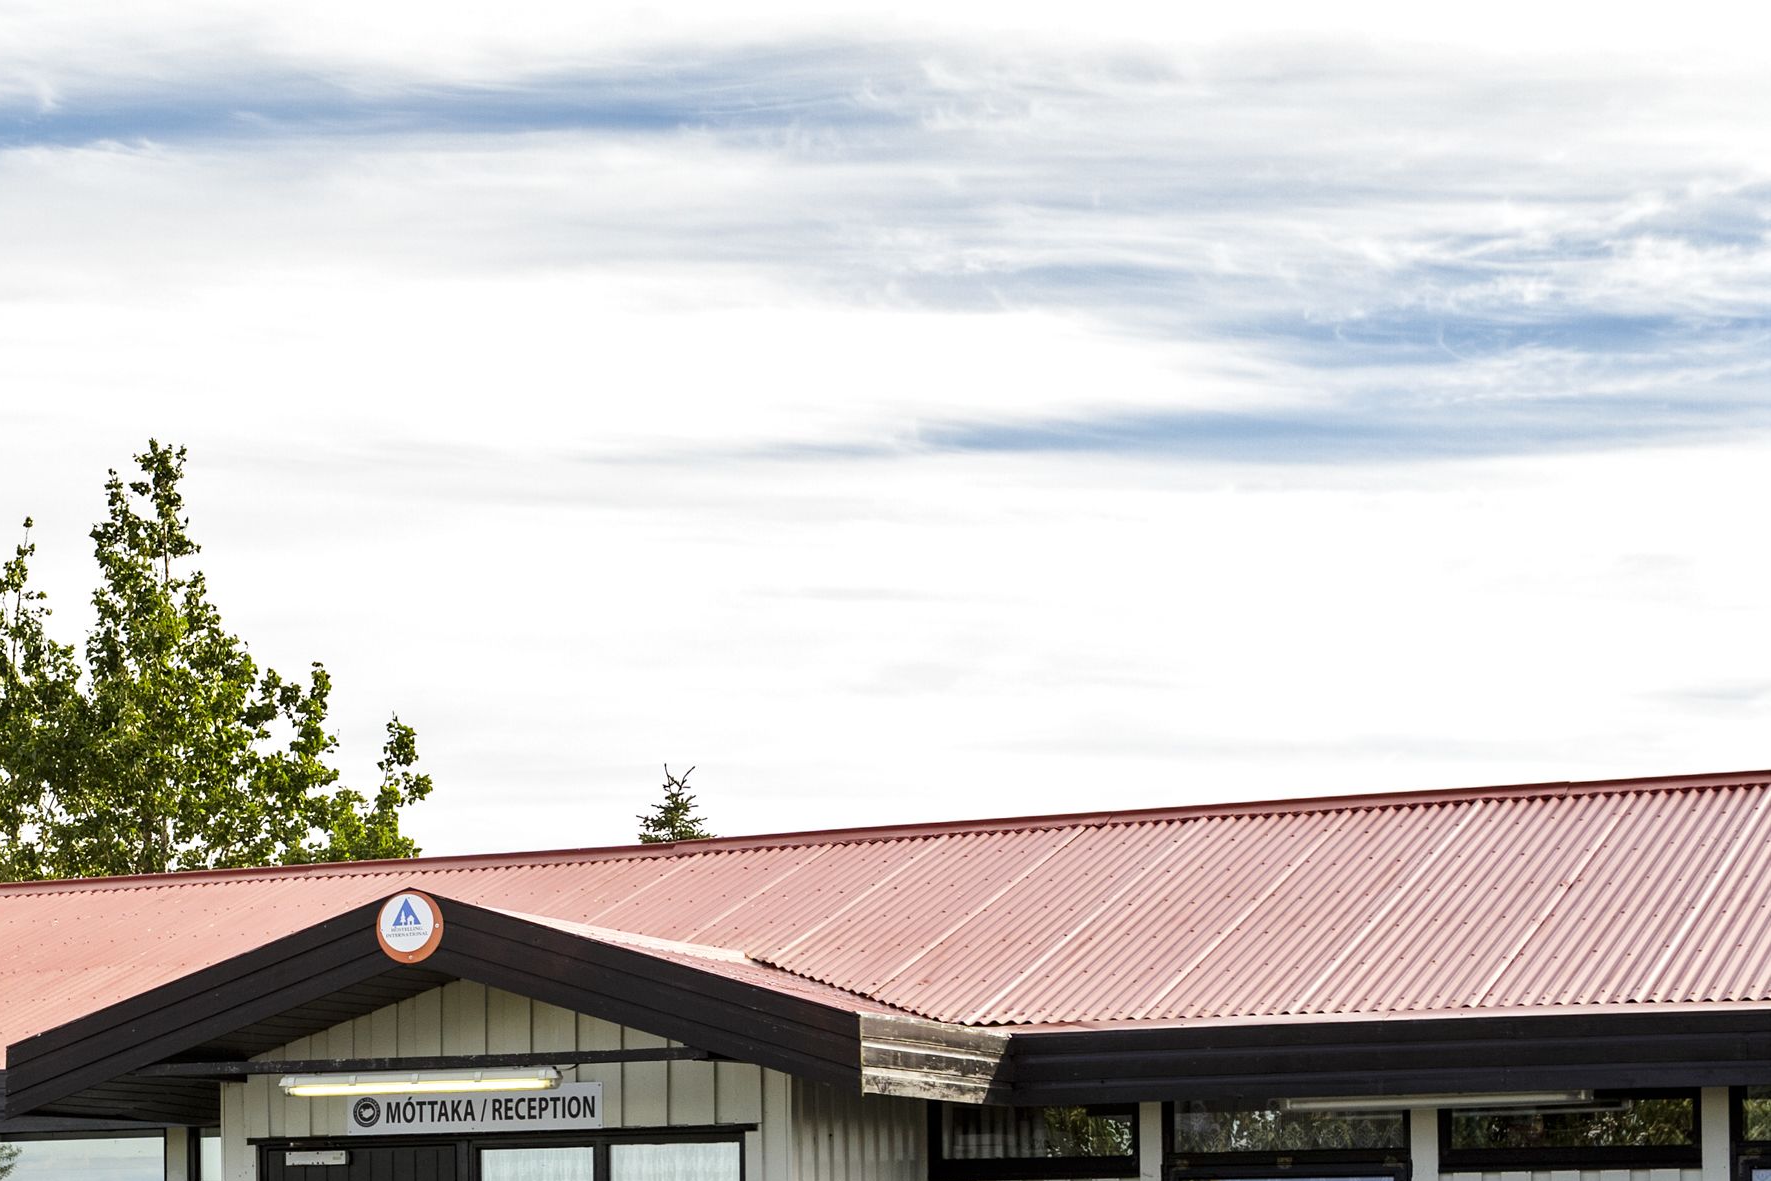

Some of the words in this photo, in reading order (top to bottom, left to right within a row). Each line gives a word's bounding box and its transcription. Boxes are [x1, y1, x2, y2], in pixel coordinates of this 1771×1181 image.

[386, 1096, 476, 1124] MÓTTAKA
[480, 1099, 487, 1122] /
[492, 1096, 595, 1121] RECEPTION
